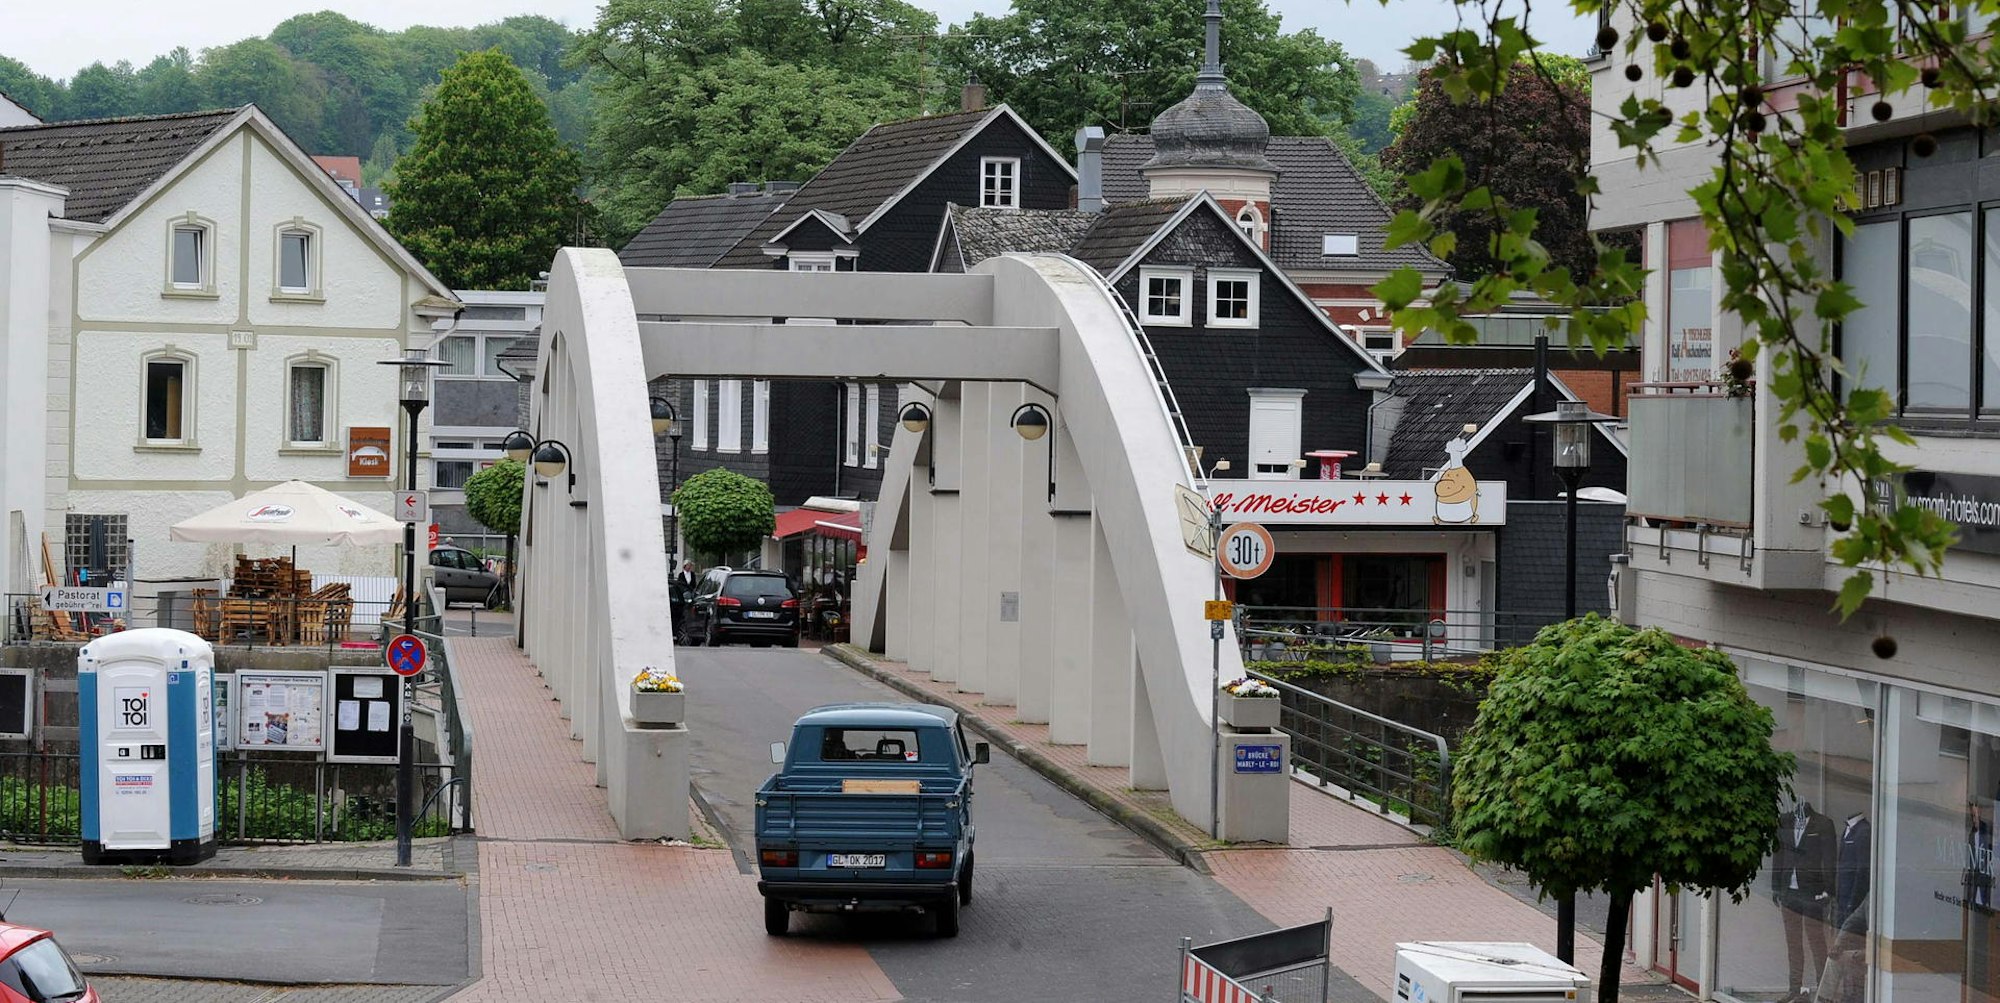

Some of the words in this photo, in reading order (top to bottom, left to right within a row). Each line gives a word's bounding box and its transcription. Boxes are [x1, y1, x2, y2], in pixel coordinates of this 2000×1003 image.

[359, 457, 379, 466] Kiosk
[57, 589, 100, 600] Pastorat
[122, 712, 147, 726] TOI
[1248, 751, 1269, 759] BRÜCKE
[832, 855, 844, 865] GL
[863, 855, 884, 865] 2017
